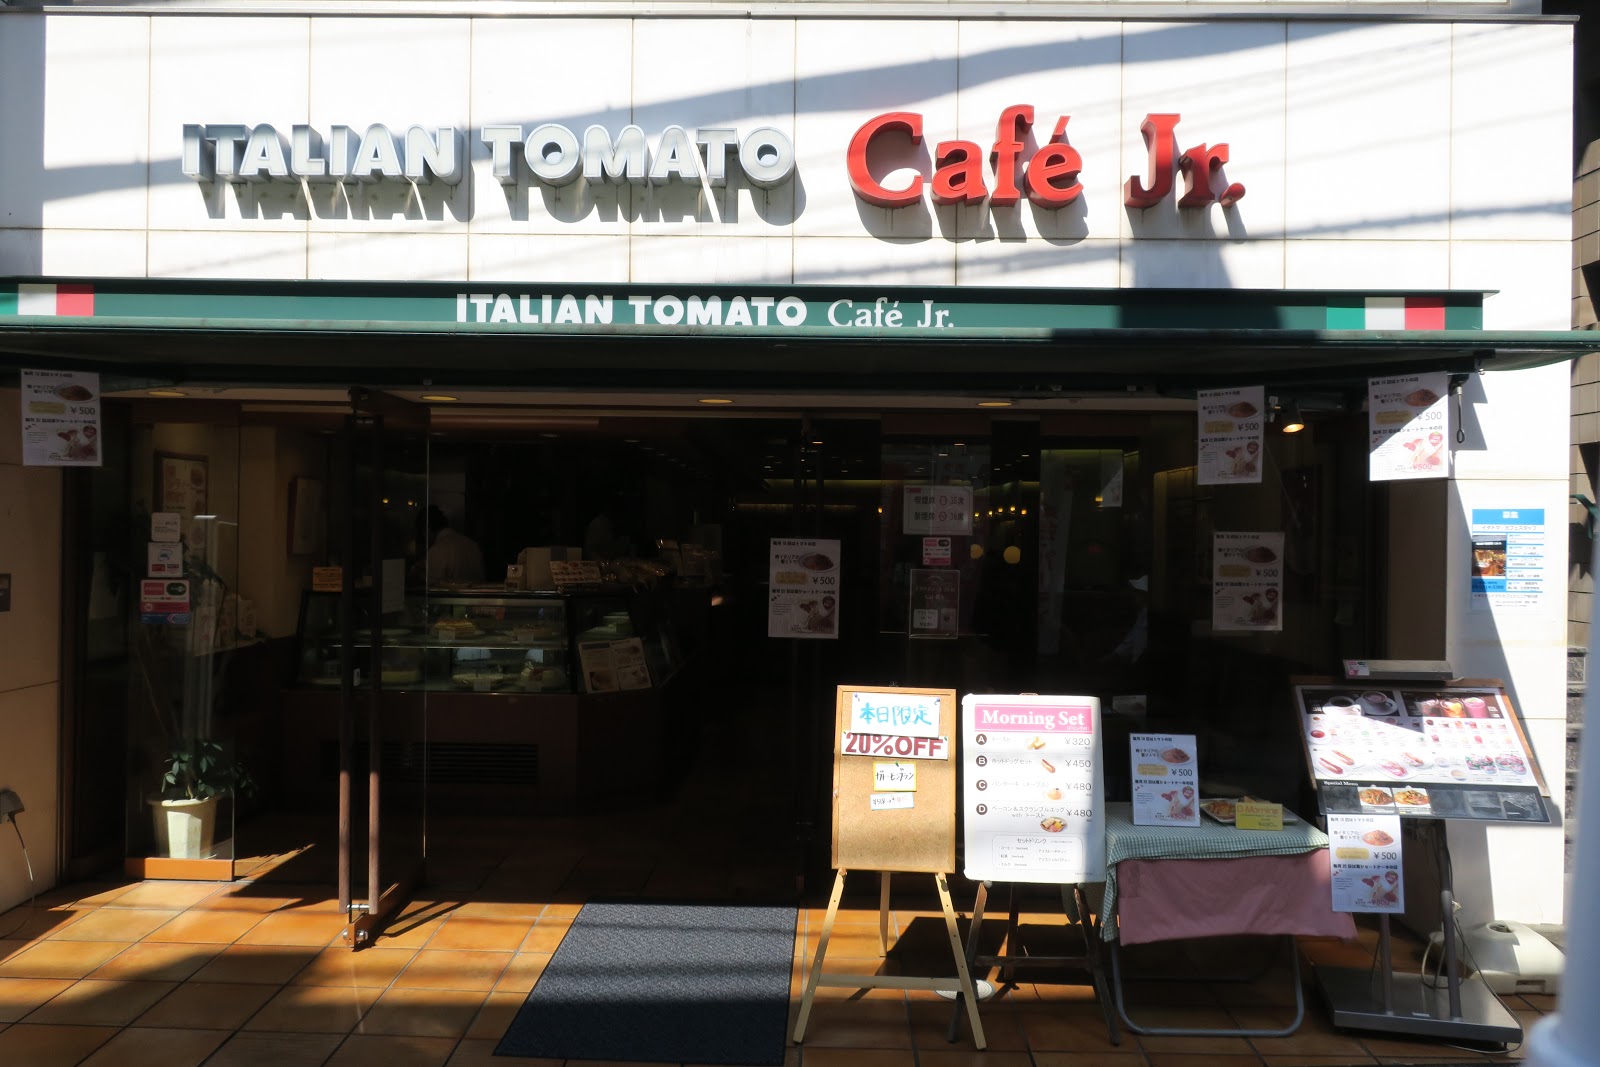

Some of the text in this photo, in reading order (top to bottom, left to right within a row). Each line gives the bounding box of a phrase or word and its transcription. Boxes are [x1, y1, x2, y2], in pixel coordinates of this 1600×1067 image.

[182, 104, 1247, 208] ITALIAN TOMATO Café Jr.
[456, 293, 955, 329] ITALIAN TOMATO Café Jr.
[860, 702, 932, 727] 本日限定
[981, 709, 1085, 730] Morning Set
[977, 735, 987, 744] A
[1064, 737, 1091, 746] ¥320
[845, 732, 944, 757] 20%OFF
[977, 757, 987, 766] B
[1065, 759, 1092, 768] ¥450
[1171, 768, 1193, 777] ¥500
[977, 781, 987, 790] C
[1065, 783, 1092, 791] ¥480
[977, 805, 987, 814] D
[1066, 809, 1093, 818] ¥480
[1016, 837, 1047, 845] セットドリンク
[1373, 851, 1397, 860] ¥500
